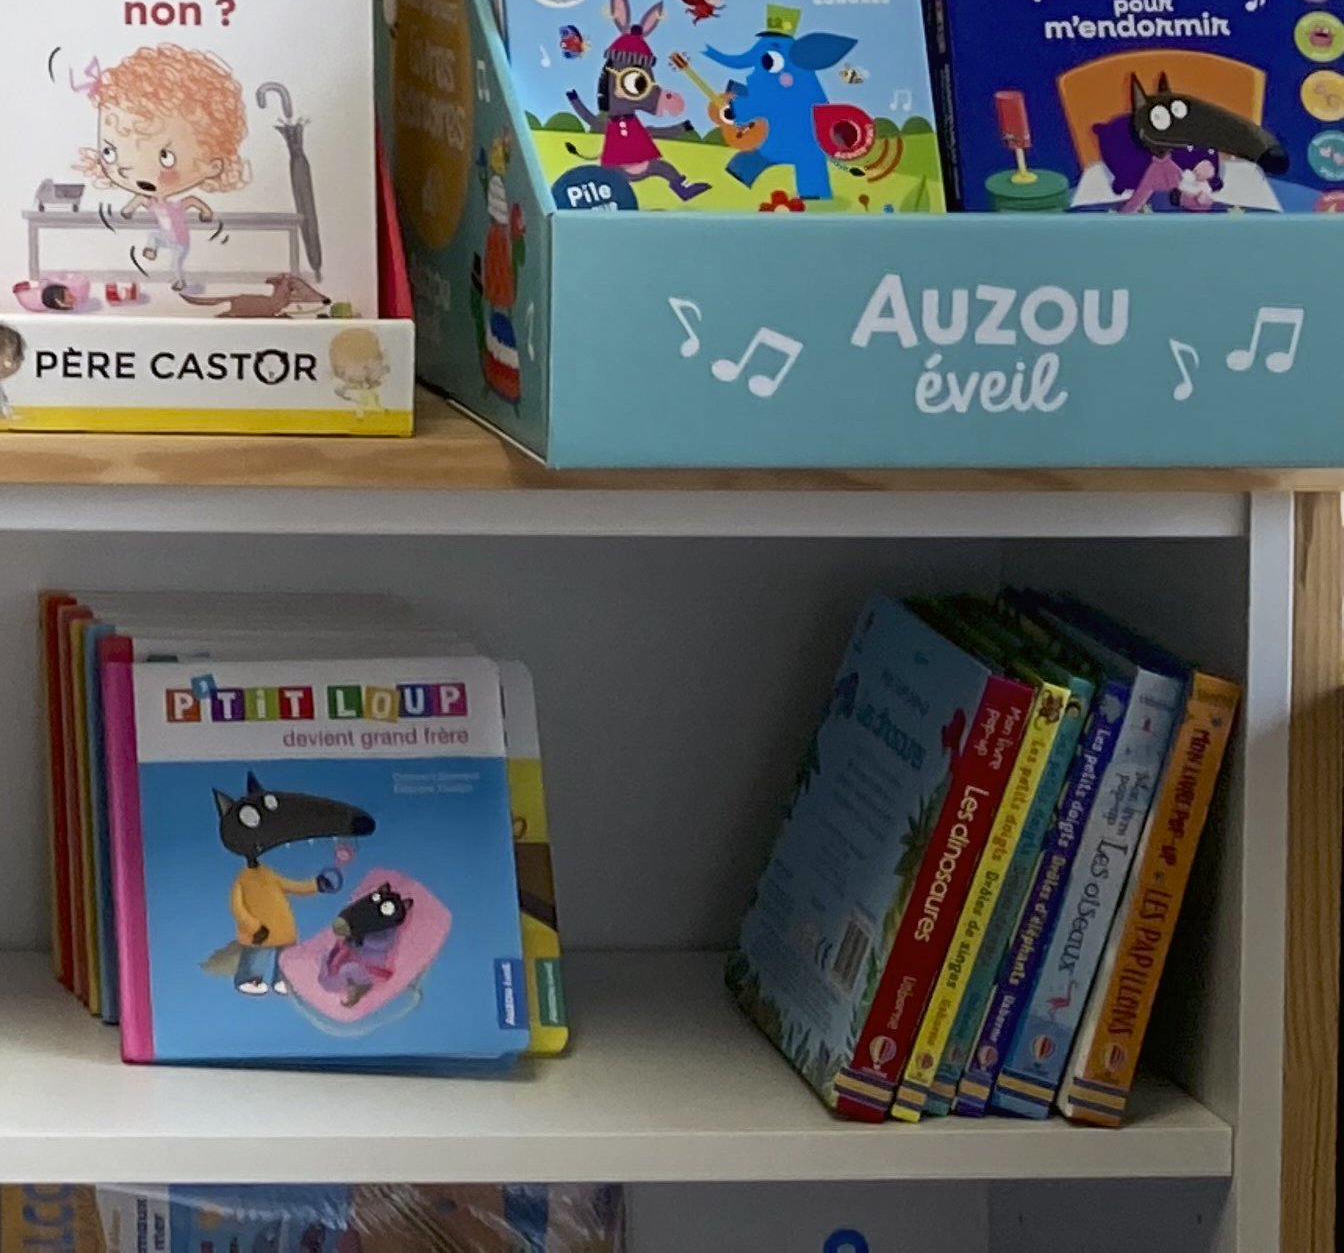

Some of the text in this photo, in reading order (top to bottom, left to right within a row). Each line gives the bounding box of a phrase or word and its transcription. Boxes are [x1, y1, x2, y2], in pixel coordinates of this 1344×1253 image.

[123, 0, 202, 26] non
[1044, 11, 1231, 40] m'endormir
[566, 181, 613, 207] Pile
[851, 271, 1133, 350] AUZOU
[35, 346, 318, 385] PÈRE CASTOR
[914, 351, 1069, 417] éveil
[326, 682, 469, 723] LOUP
[282, 726, 470, 750] devient grand frère
[1056, 836, 1129, 980] Les oiseaux
[1139, 886, 1174, 927] LES
[1107, 922, 1163, 1040] PAPILLONS
